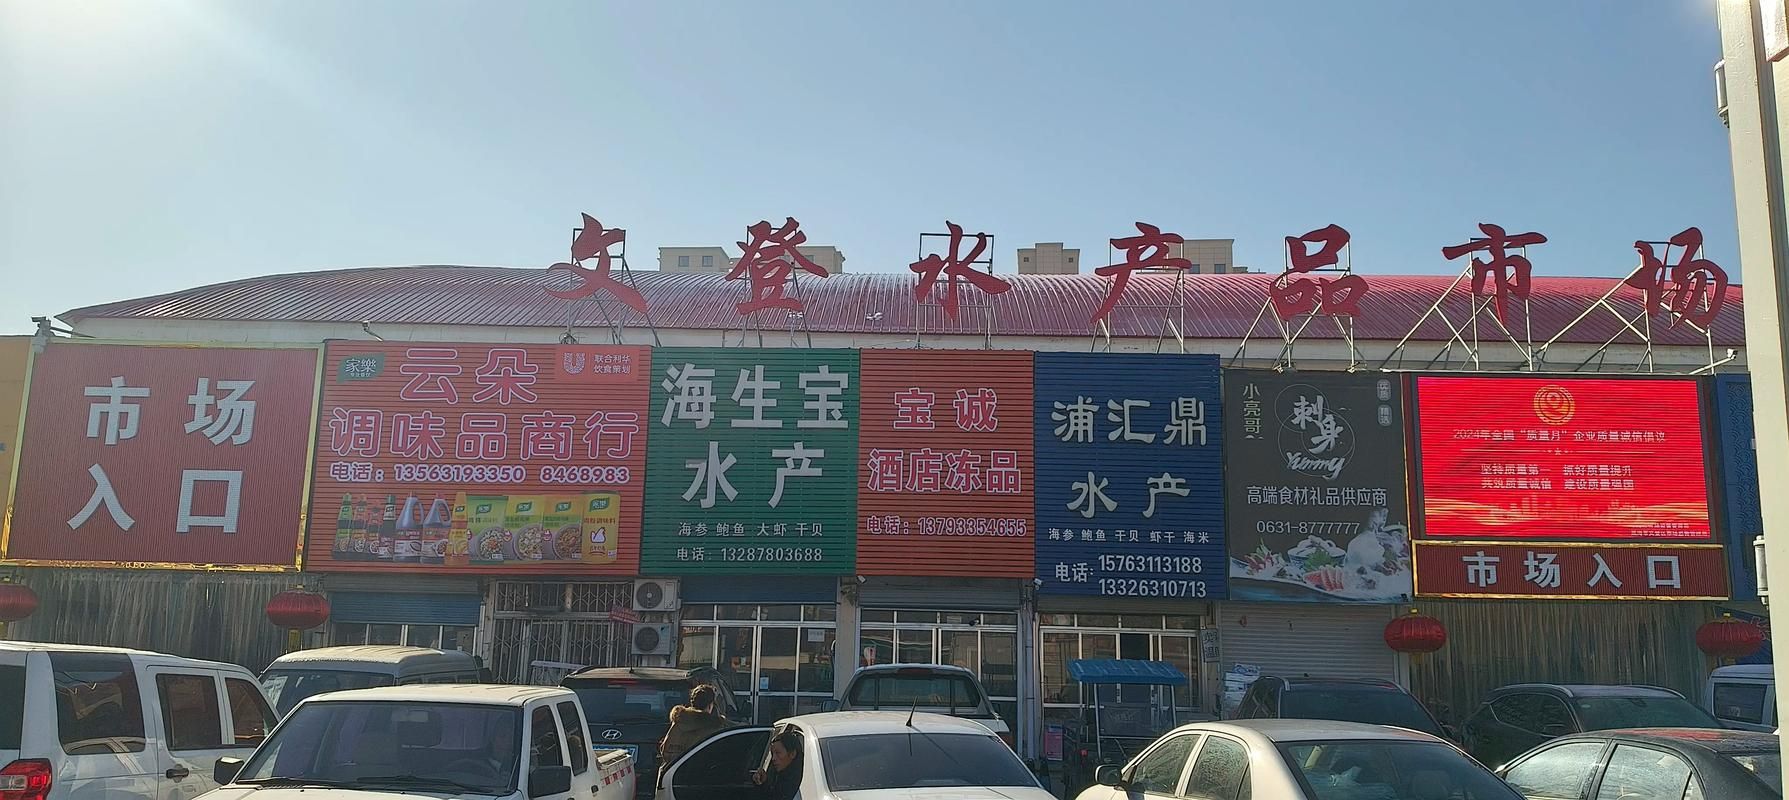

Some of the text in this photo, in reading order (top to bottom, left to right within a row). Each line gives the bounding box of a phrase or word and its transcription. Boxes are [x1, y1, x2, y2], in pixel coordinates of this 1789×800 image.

[543, 212, 1728, 329] 文登水产品市场
[399, 348, 539, 405] 云朵
[661, 362, 849, 429] 海生宝
[84, 376, 257, 446] 市场
[893, 387, 999, 432] 宝诚
[1051, 395, 1207, 447] 浦汇鼎
[1243, 383, 1261, 434] 小亮哥
[1291, 395, 1344, 454] 刺身
[329, 407, 639, 460] 调味品商行
[539, 465, 631, 484] 8468983
[681, 441, 825, 509] 水产
[867, 447, 1022, 494] 酒店冻品
[1286, 452, 1346, 480] Yummy
[67, 463, 244, 533] 入口
[1066, 471, 1191, 519] 水产
[1246, 485, 1387, 507] 高端食材礼品供应商
[678, 522, 823, 537] 海参 鲍鱼 大虾 干贝
[1048, 527, 1210, 543] 海参 鲍鱼 干贝 虾干 海米
[1256, 520, 1361, 535] 0631-8777777
[1054, 555, 1202, 583] 电话： 15763113188
[1099, 577, 1207, 598] 13326310713
[1462, 550, 1682, 590] 市场入口
